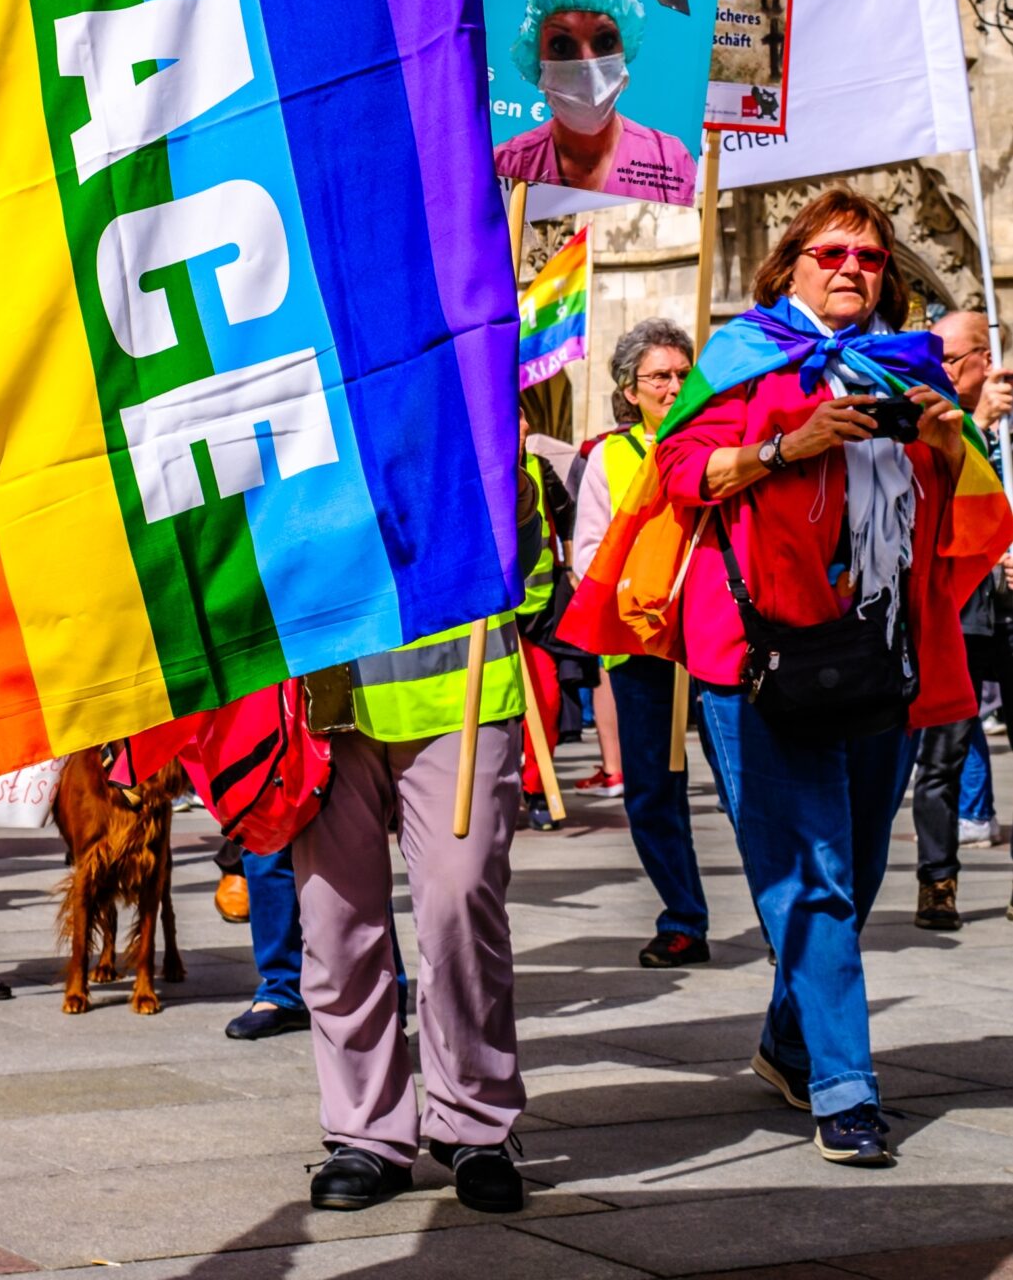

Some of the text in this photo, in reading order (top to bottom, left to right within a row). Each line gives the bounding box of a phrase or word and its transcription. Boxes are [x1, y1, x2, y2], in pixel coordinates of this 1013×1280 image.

[715, 8, 761, 25] icheres
[712, 32, 752, 48] schäft
[489, 100, 545, 122] en €
[723, 130, 788, 152] chen
[616, 166, 635, 175] aktiv
[636, 170, 658, 179] gegen
